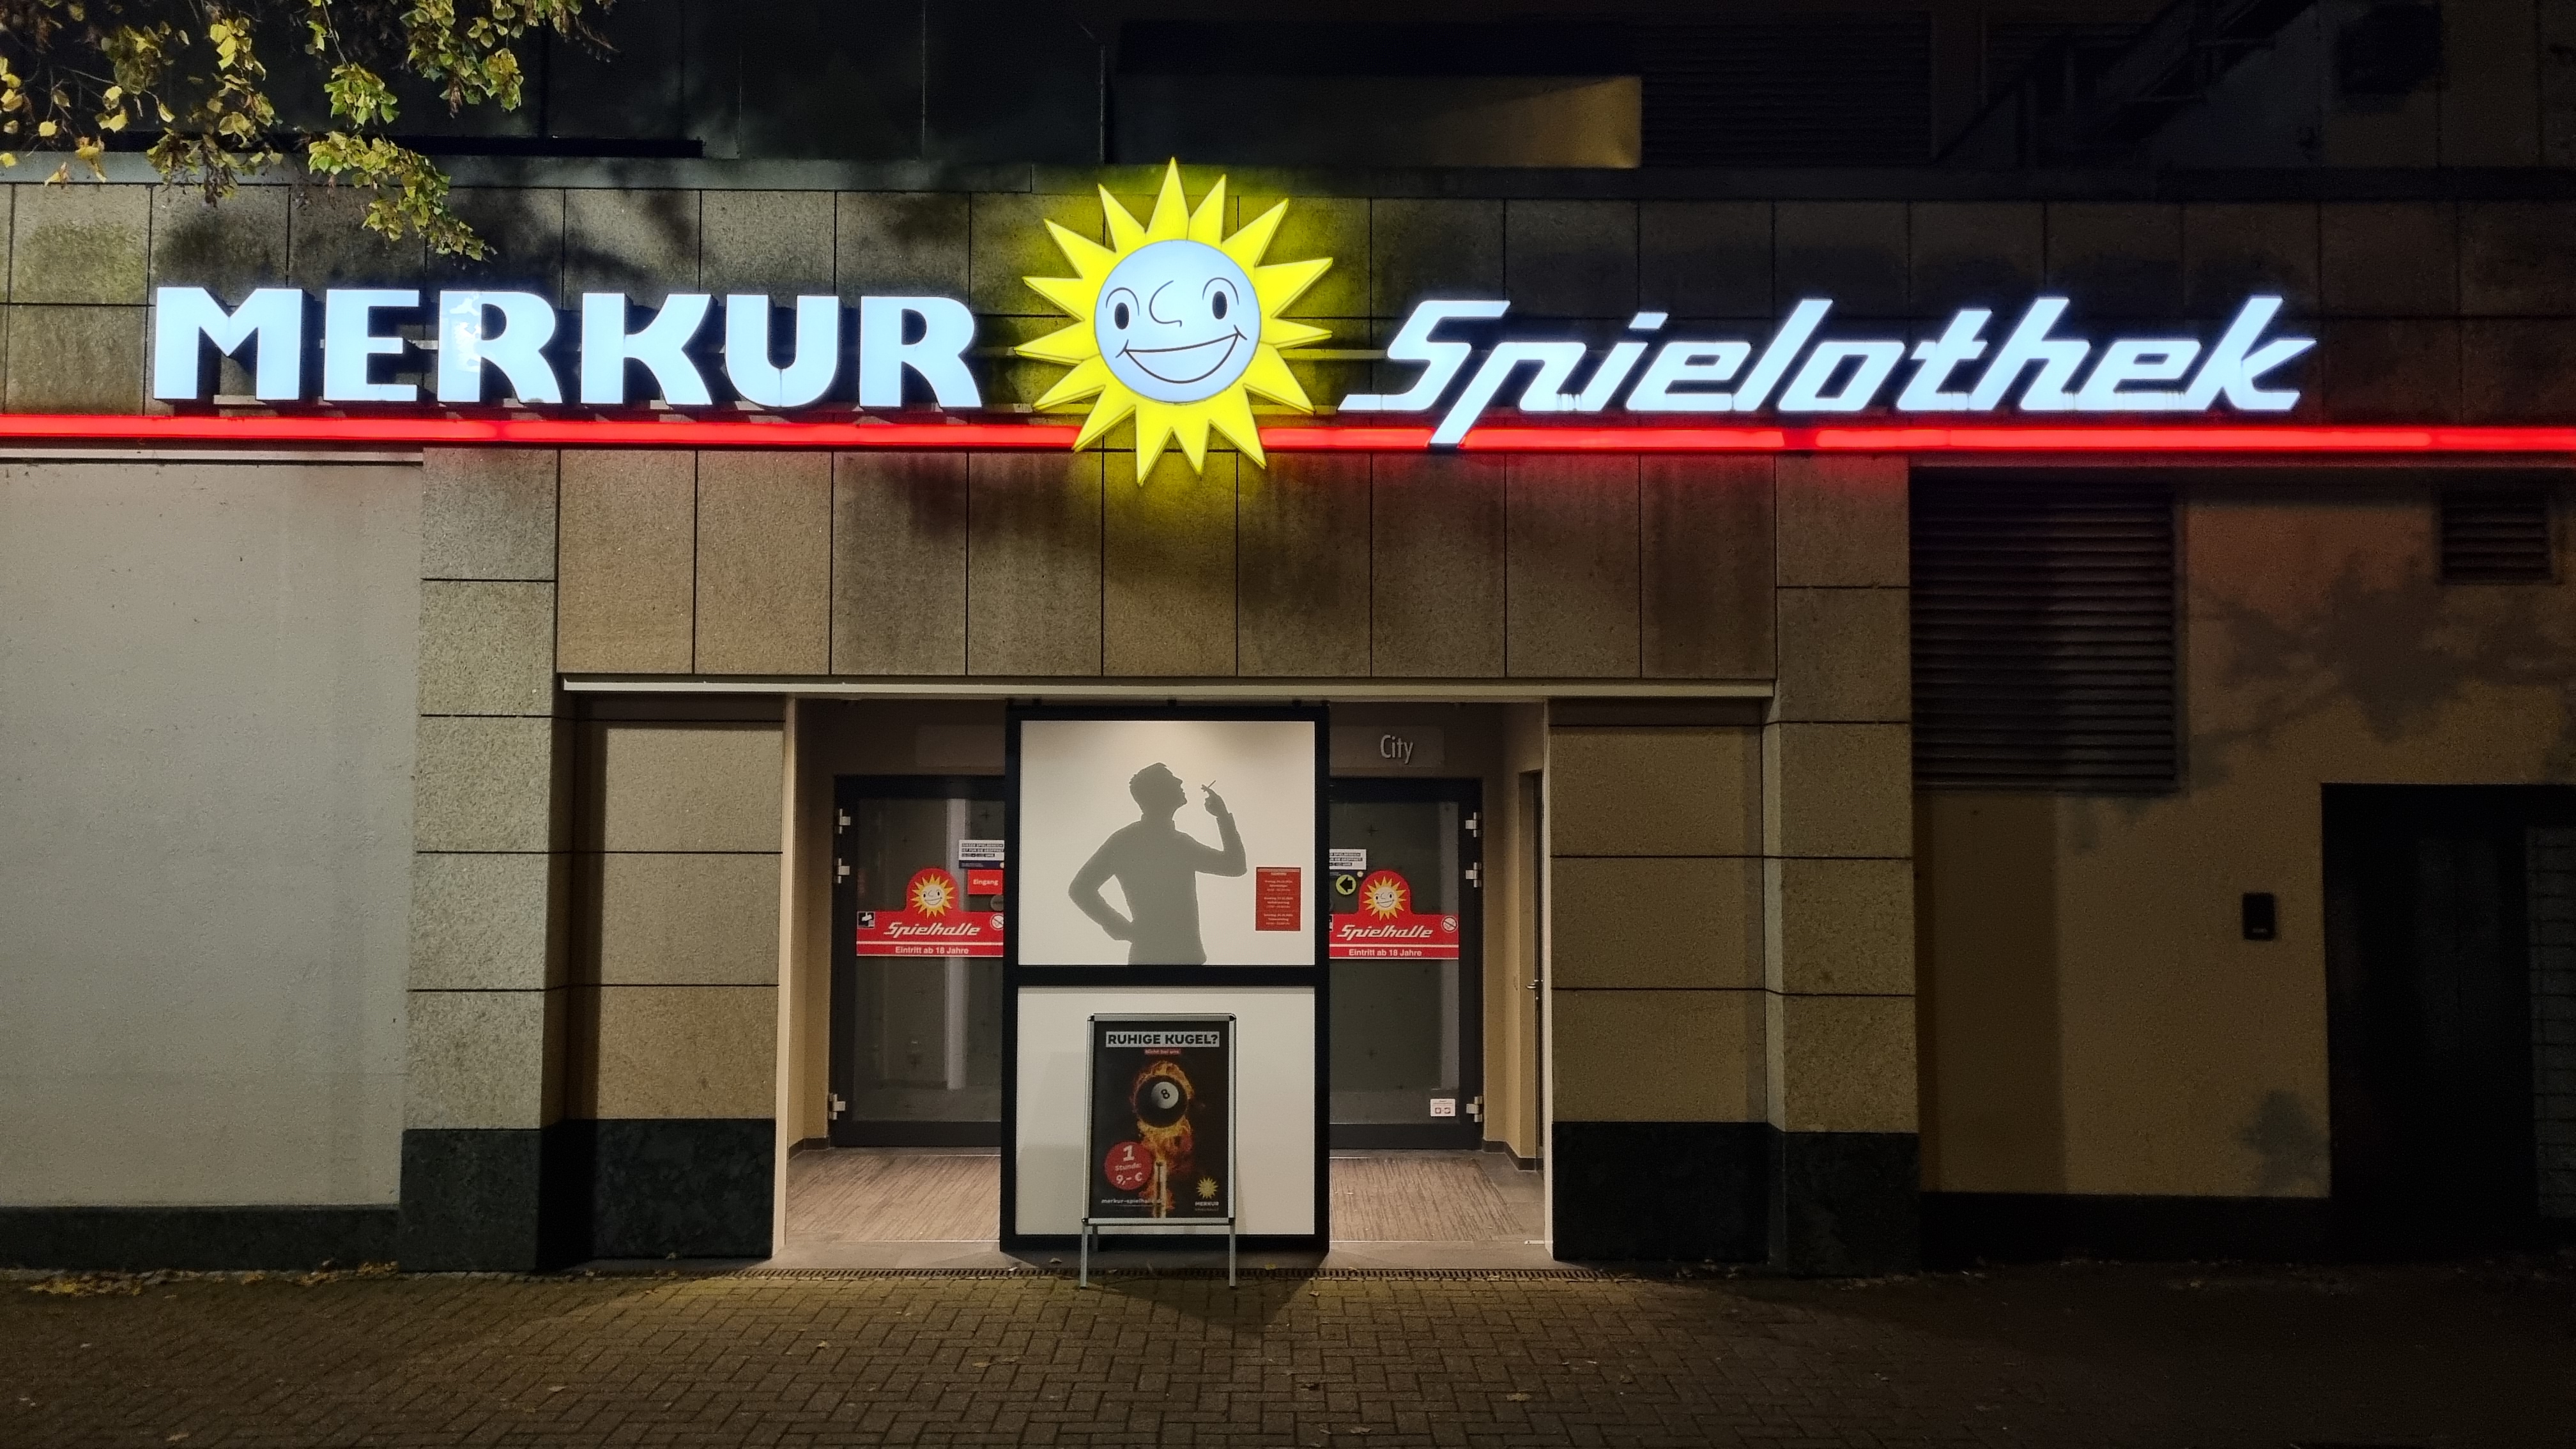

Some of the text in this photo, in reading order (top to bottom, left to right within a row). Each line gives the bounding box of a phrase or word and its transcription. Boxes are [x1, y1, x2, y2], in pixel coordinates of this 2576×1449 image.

[153, 286, 2318, 448] MERKUR Spielothek
[1380, 734, 1414, 764] City
[884, 922, 981, 938] Spielhalle
[1337, 924, 1433, 941] Spielhalle
[1107, 1034, 1218, 1045] RUHIGE KUGEL?
[1161, 1089, 1170, 1100] 8
[1123, 1145, 1135, 1162] 1
[1134, 1172, 1142, 1182] €
